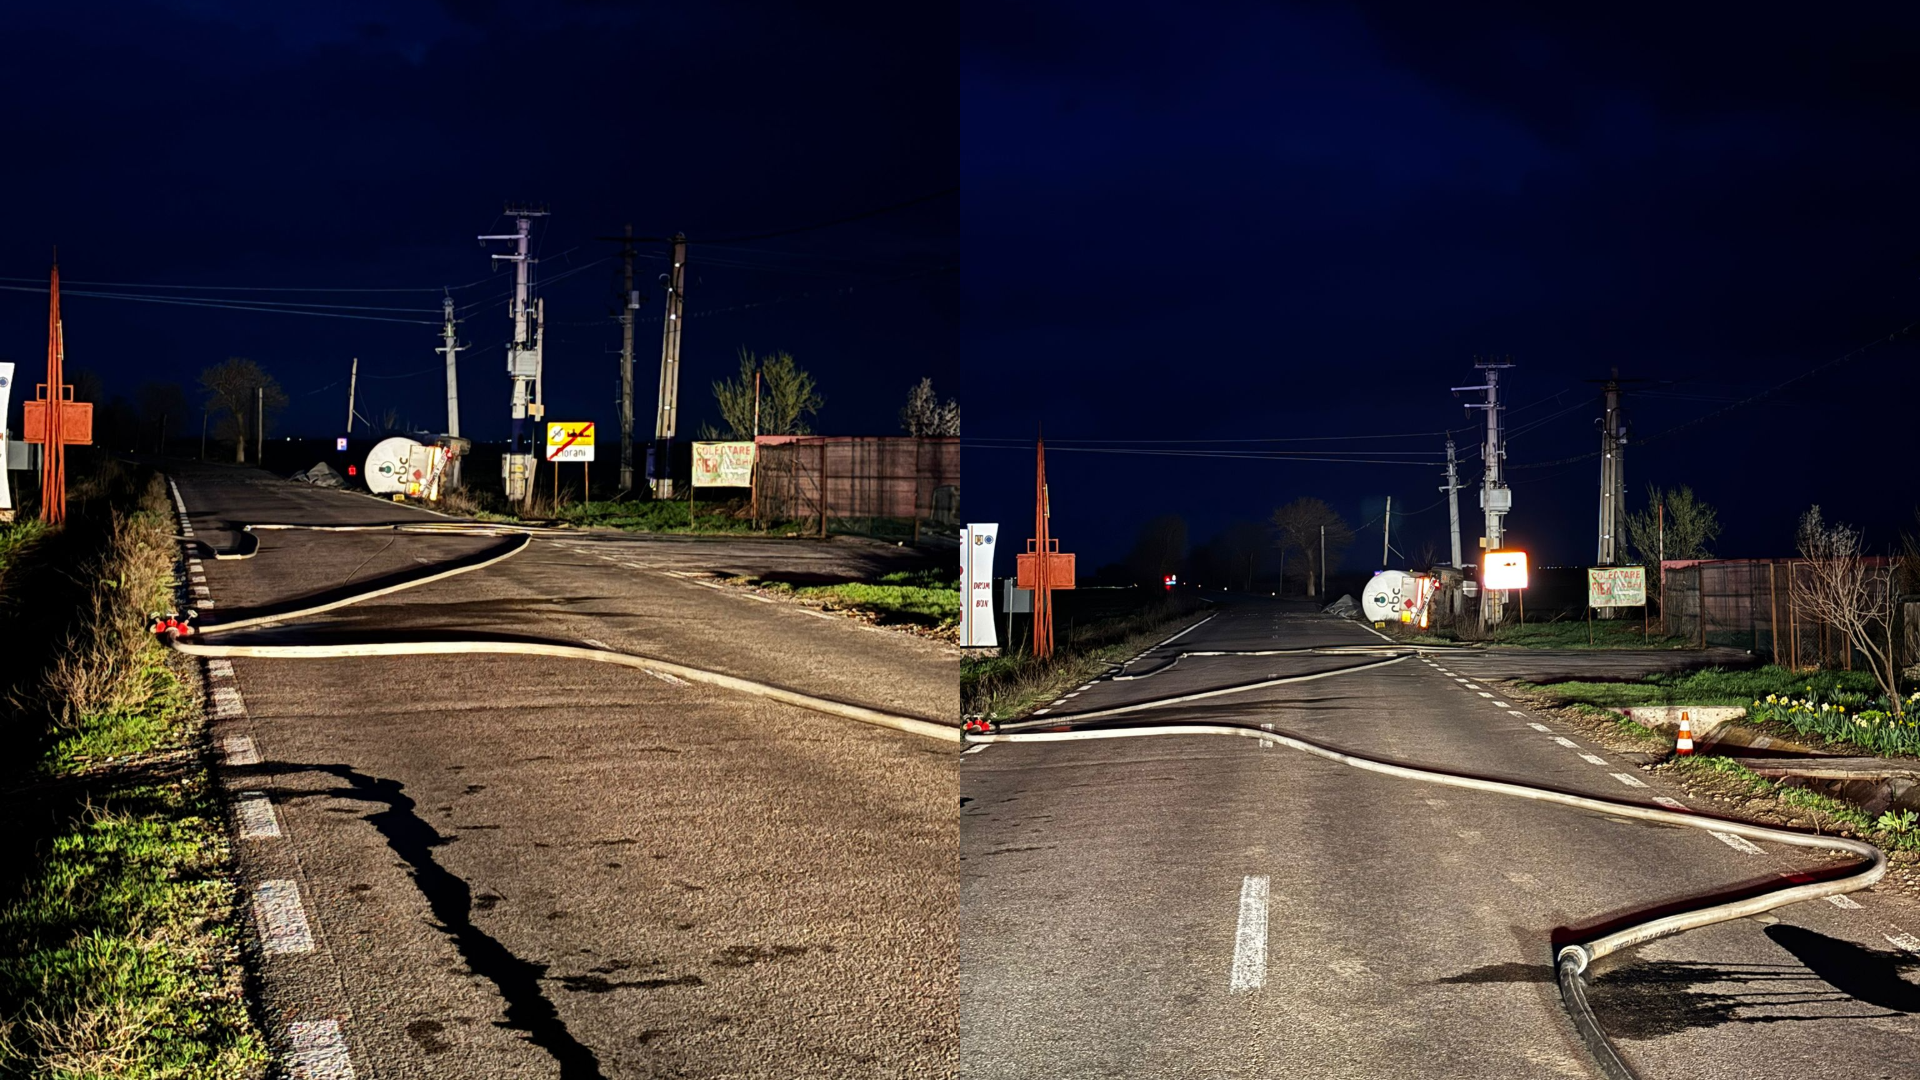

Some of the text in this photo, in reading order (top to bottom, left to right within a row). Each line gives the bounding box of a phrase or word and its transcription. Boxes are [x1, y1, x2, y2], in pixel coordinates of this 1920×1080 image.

[556, 447, 586, 458] iorani
[394, 456, 409, 485] rbc
[1591, 570, 1641, 581] COLECTARE
[1389, 587, 1401, 613] rbc
